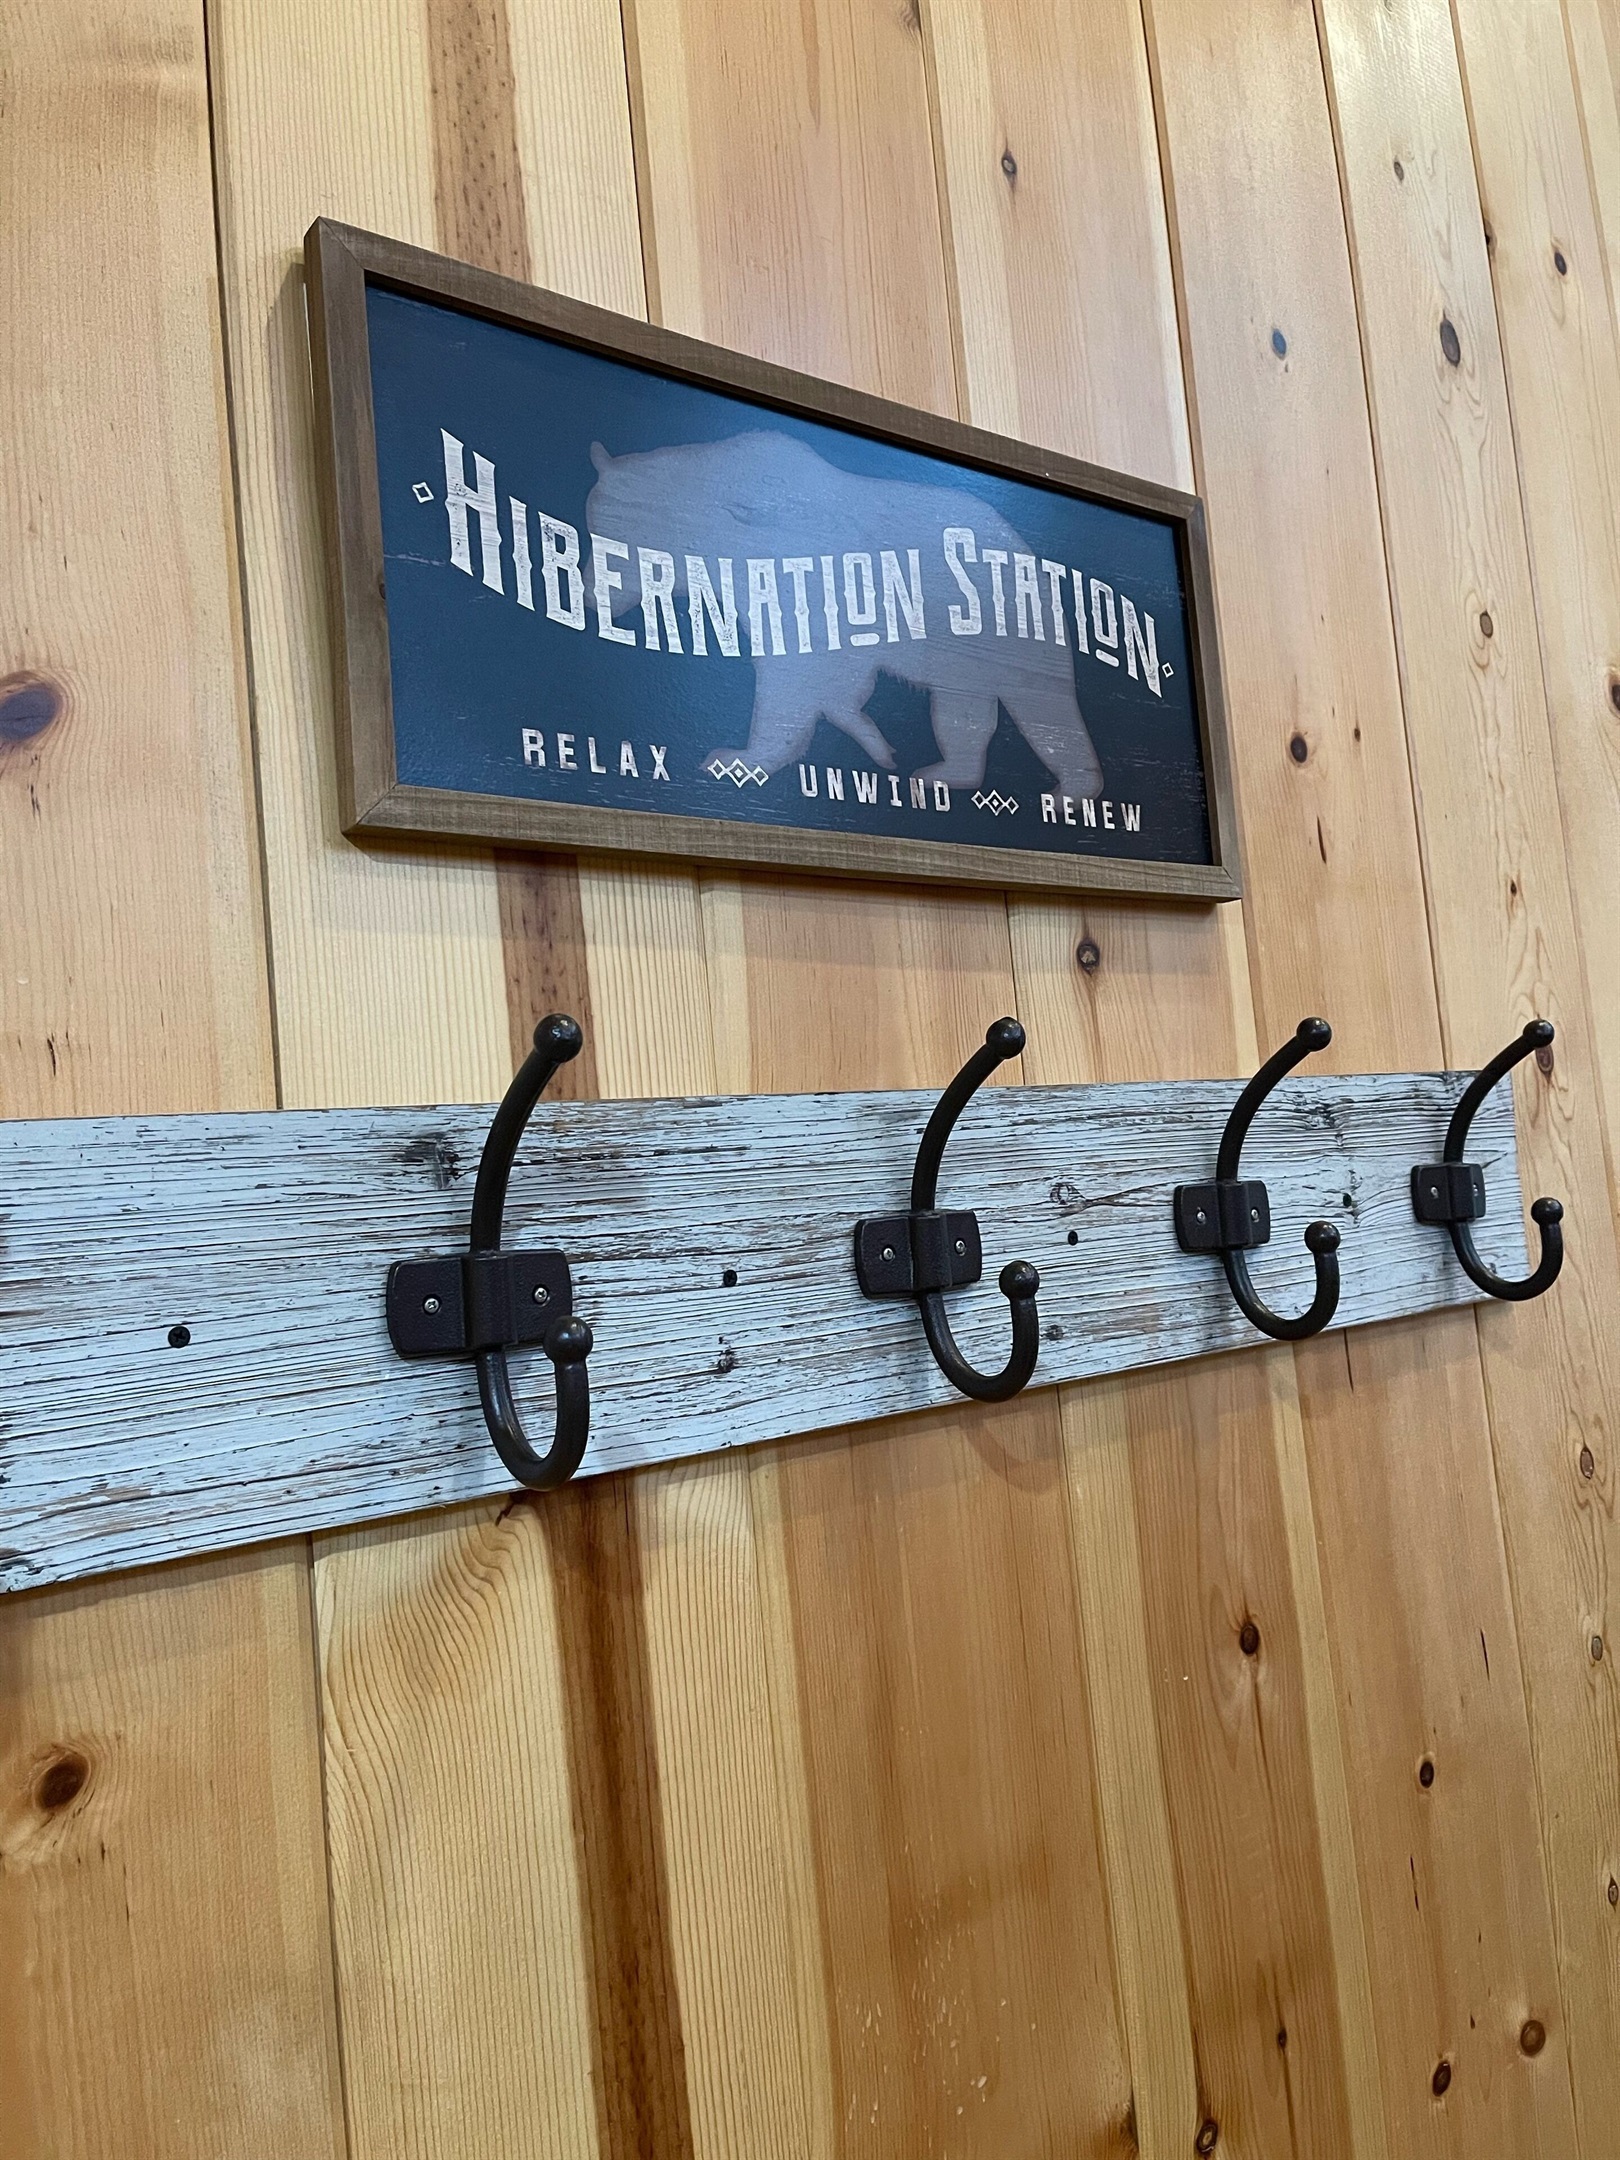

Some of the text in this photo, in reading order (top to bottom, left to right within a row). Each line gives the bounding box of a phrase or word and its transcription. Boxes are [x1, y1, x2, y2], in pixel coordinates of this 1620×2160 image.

[440, 427, 1163, 699] HIBERNATION STATION
[521, 727, 1143, 832] RELAX UNWIND RENEW
